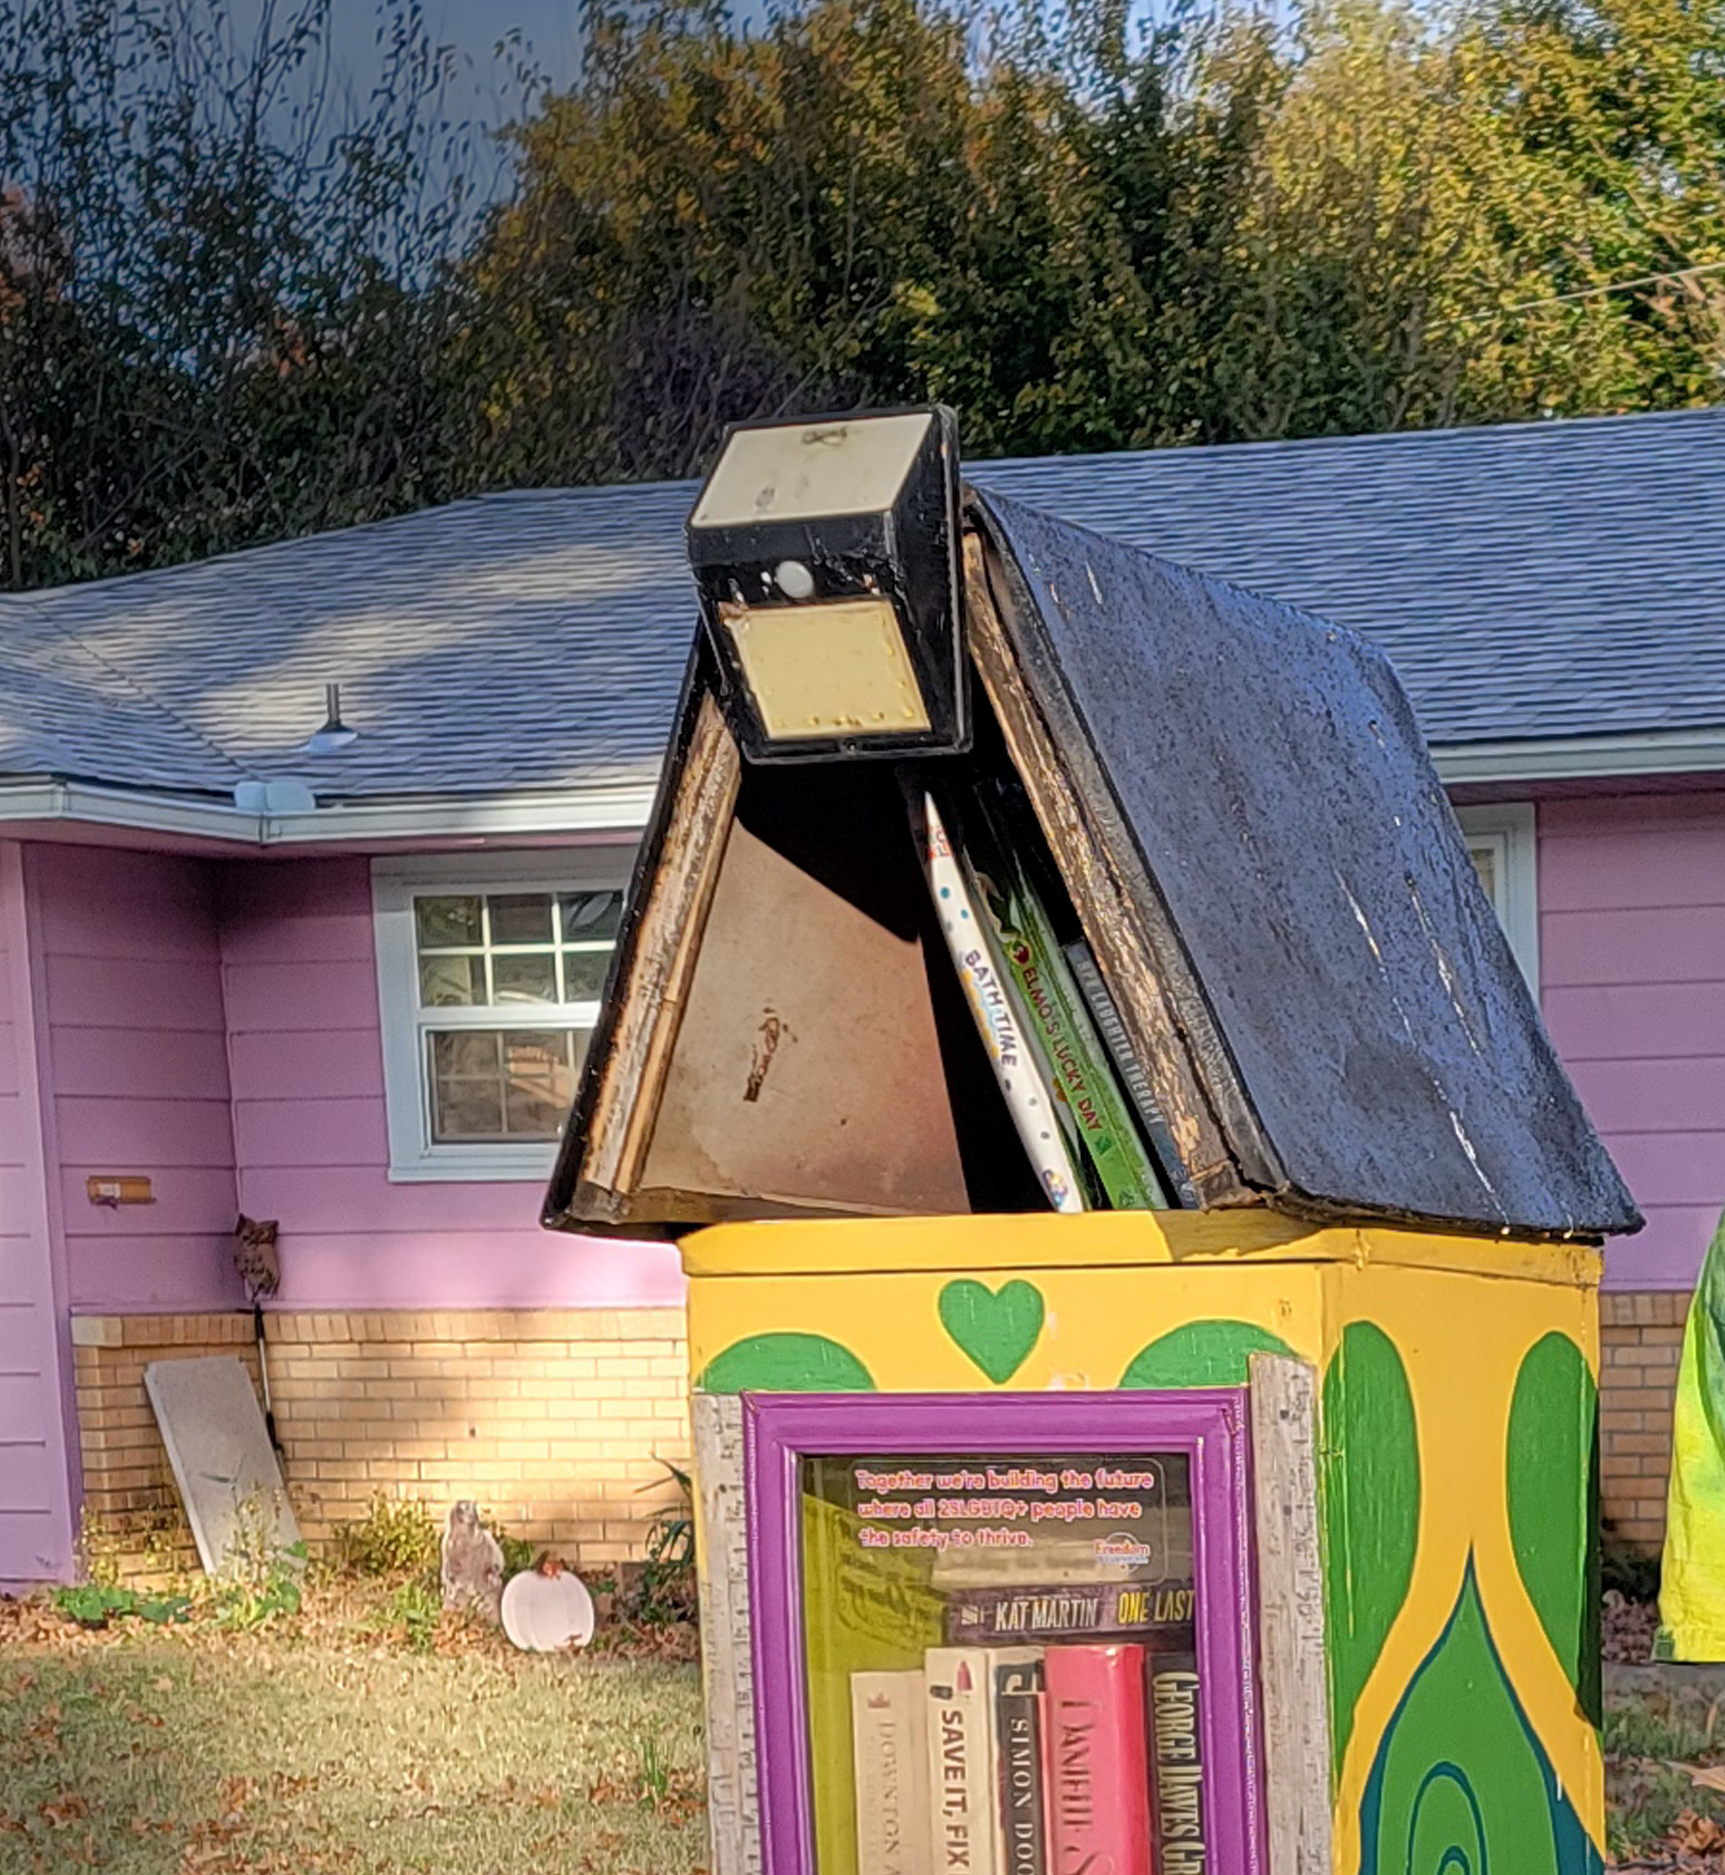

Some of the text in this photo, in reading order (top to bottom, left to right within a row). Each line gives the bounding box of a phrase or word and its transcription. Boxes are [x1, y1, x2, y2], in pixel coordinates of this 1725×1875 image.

[964, 949, 1019, 1069] BATH TIME
[1020, 966, 1104, 1132] ELMO'S LUCKY DAY
[1090, 989, 1134, 1062] LAUGHTER
[1124, 1058, 1166, 1125] THERAPY
[855, 1469, 1154, 1494] Together we're building the future
[858, 1499, 1142, 1521] where all 2SLGBTQ+ people have
[859, 1528, 1033, 1551] the safety to thrive.
[1093, 1539, 1150, 1556] Freedom
[995, 1590, 1194, 1631] KAT MARTIN ONE LAST
[941, 1709, 966, 1780] SAVE
[1152, 1671, 1200, 1760] GEORGE
[878, 1721, 901, 1855] DOWNTON
[1011, 1717, 1033, 1808] SIMON
[1061, 1699, 1093, 1831] DANIELLE
[942, 1785, 967, 1818] IT,
[1158, 1765, 1203, 1838] DAWES
[946, 1826, 970, 1868] FIX
